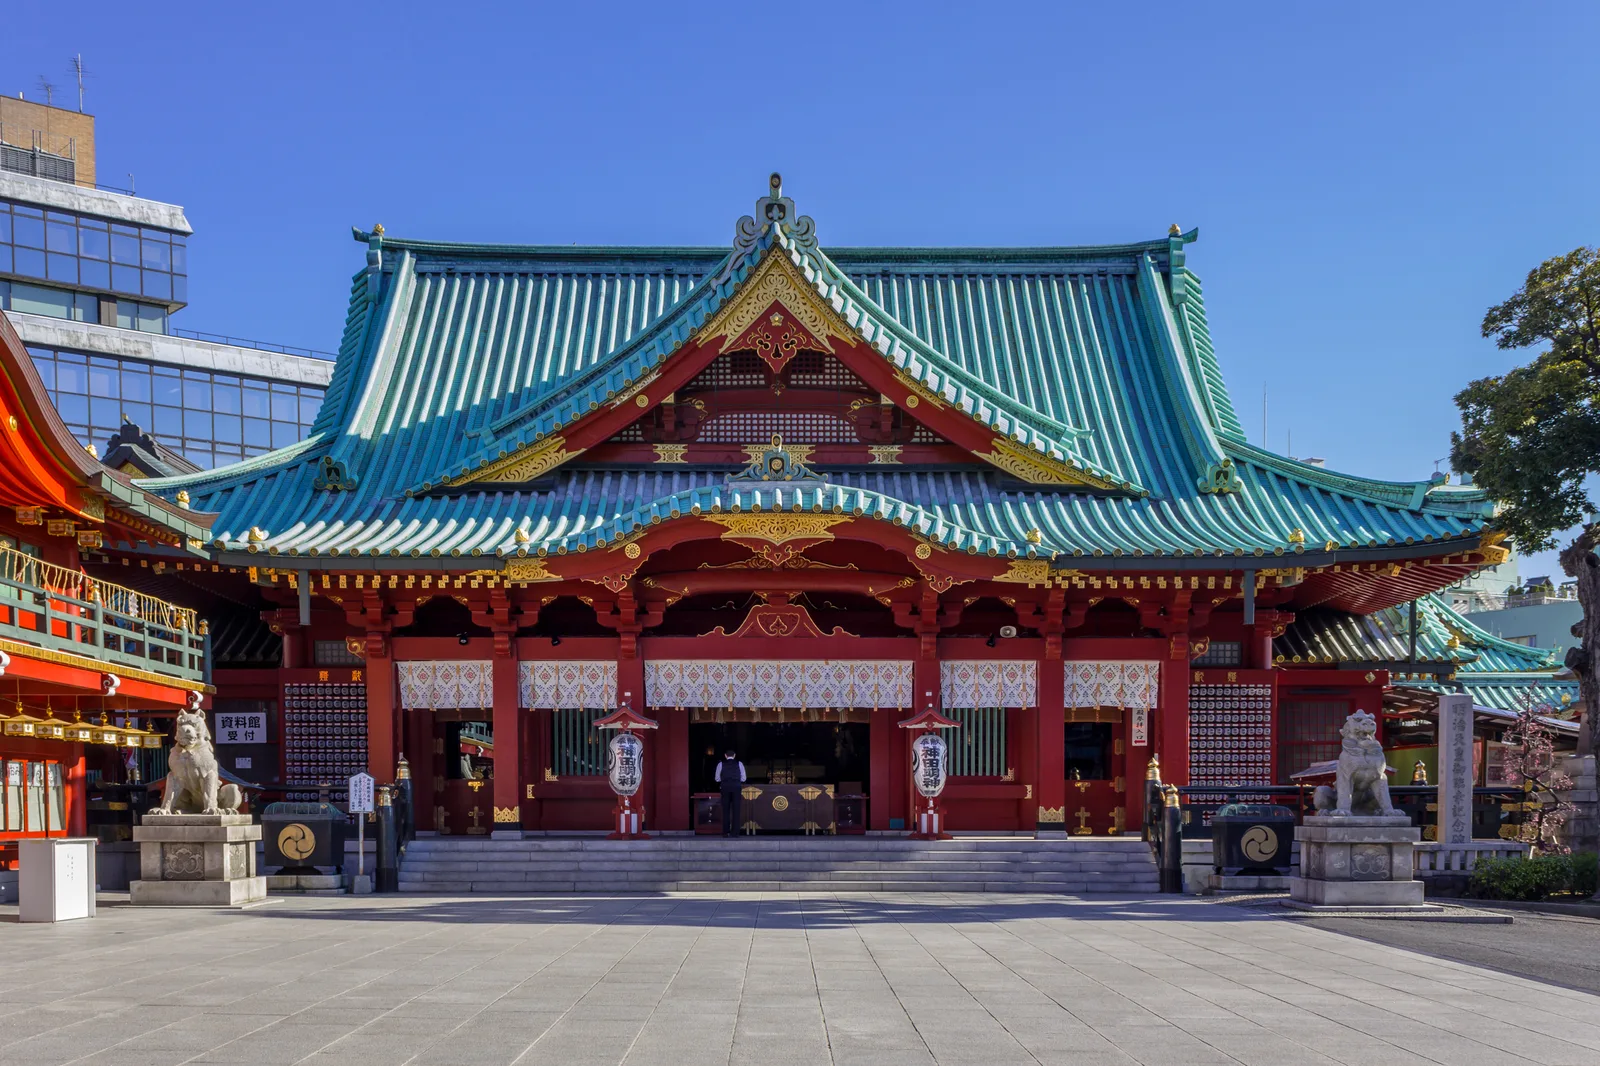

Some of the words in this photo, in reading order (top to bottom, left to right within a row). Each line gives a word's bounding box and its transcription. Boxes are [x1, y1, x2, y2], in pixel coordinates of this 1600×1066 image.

[221, 716, 260, 728] 資料館
[228, 730, 255, 741] 受付
[617, 745, 637, 787] 神田明神
[921, 746, 941, 788] 神田明神
